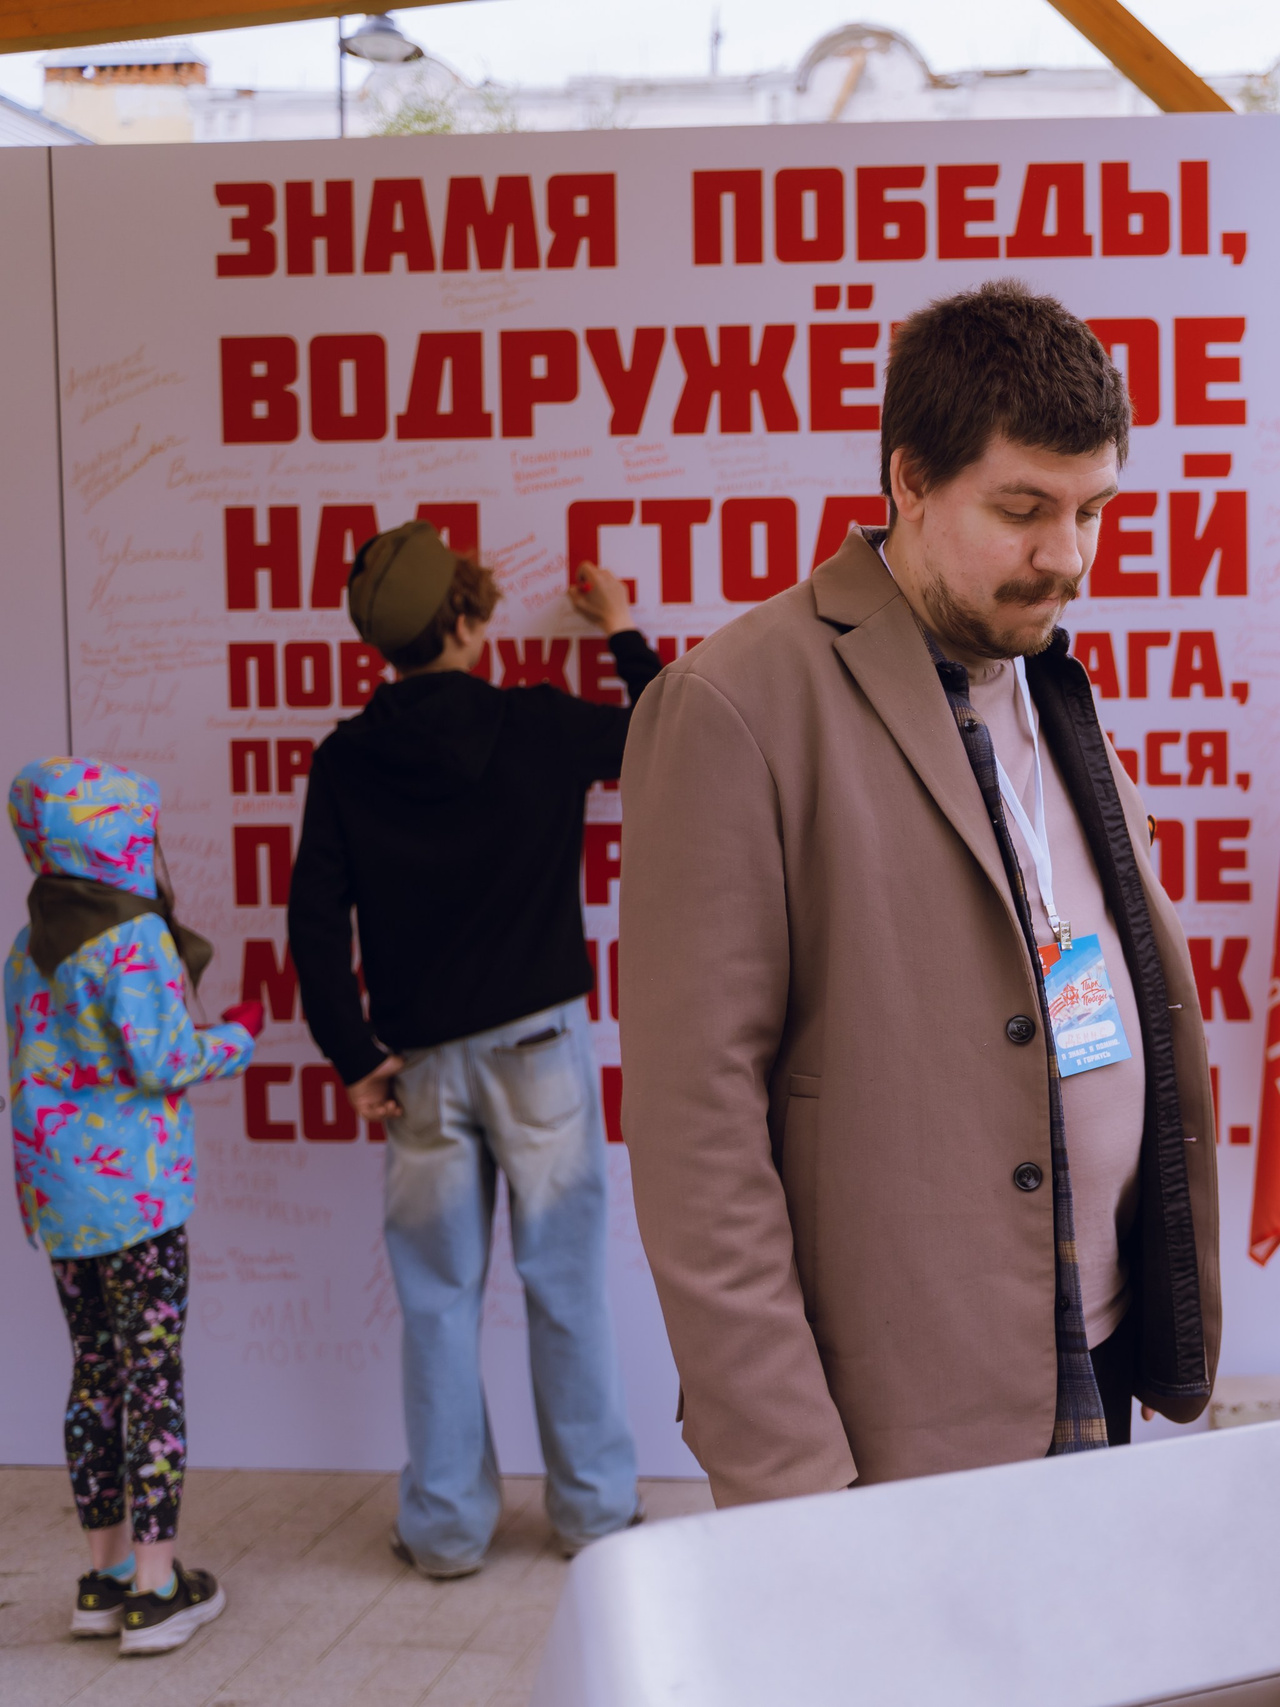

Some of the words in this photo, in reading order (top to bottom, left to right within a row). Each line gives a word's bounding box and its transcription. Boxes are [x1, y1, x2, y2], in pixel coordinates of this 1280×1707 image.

[213, 172, 617, 278] ЗНАМЯ
[692, 160, 1249, 266] ПОБЕДЫ,
[219, 284, 1247, 446] ВОДРУЖЁОЕ
[1081, 978, 1102, 991] Парк
